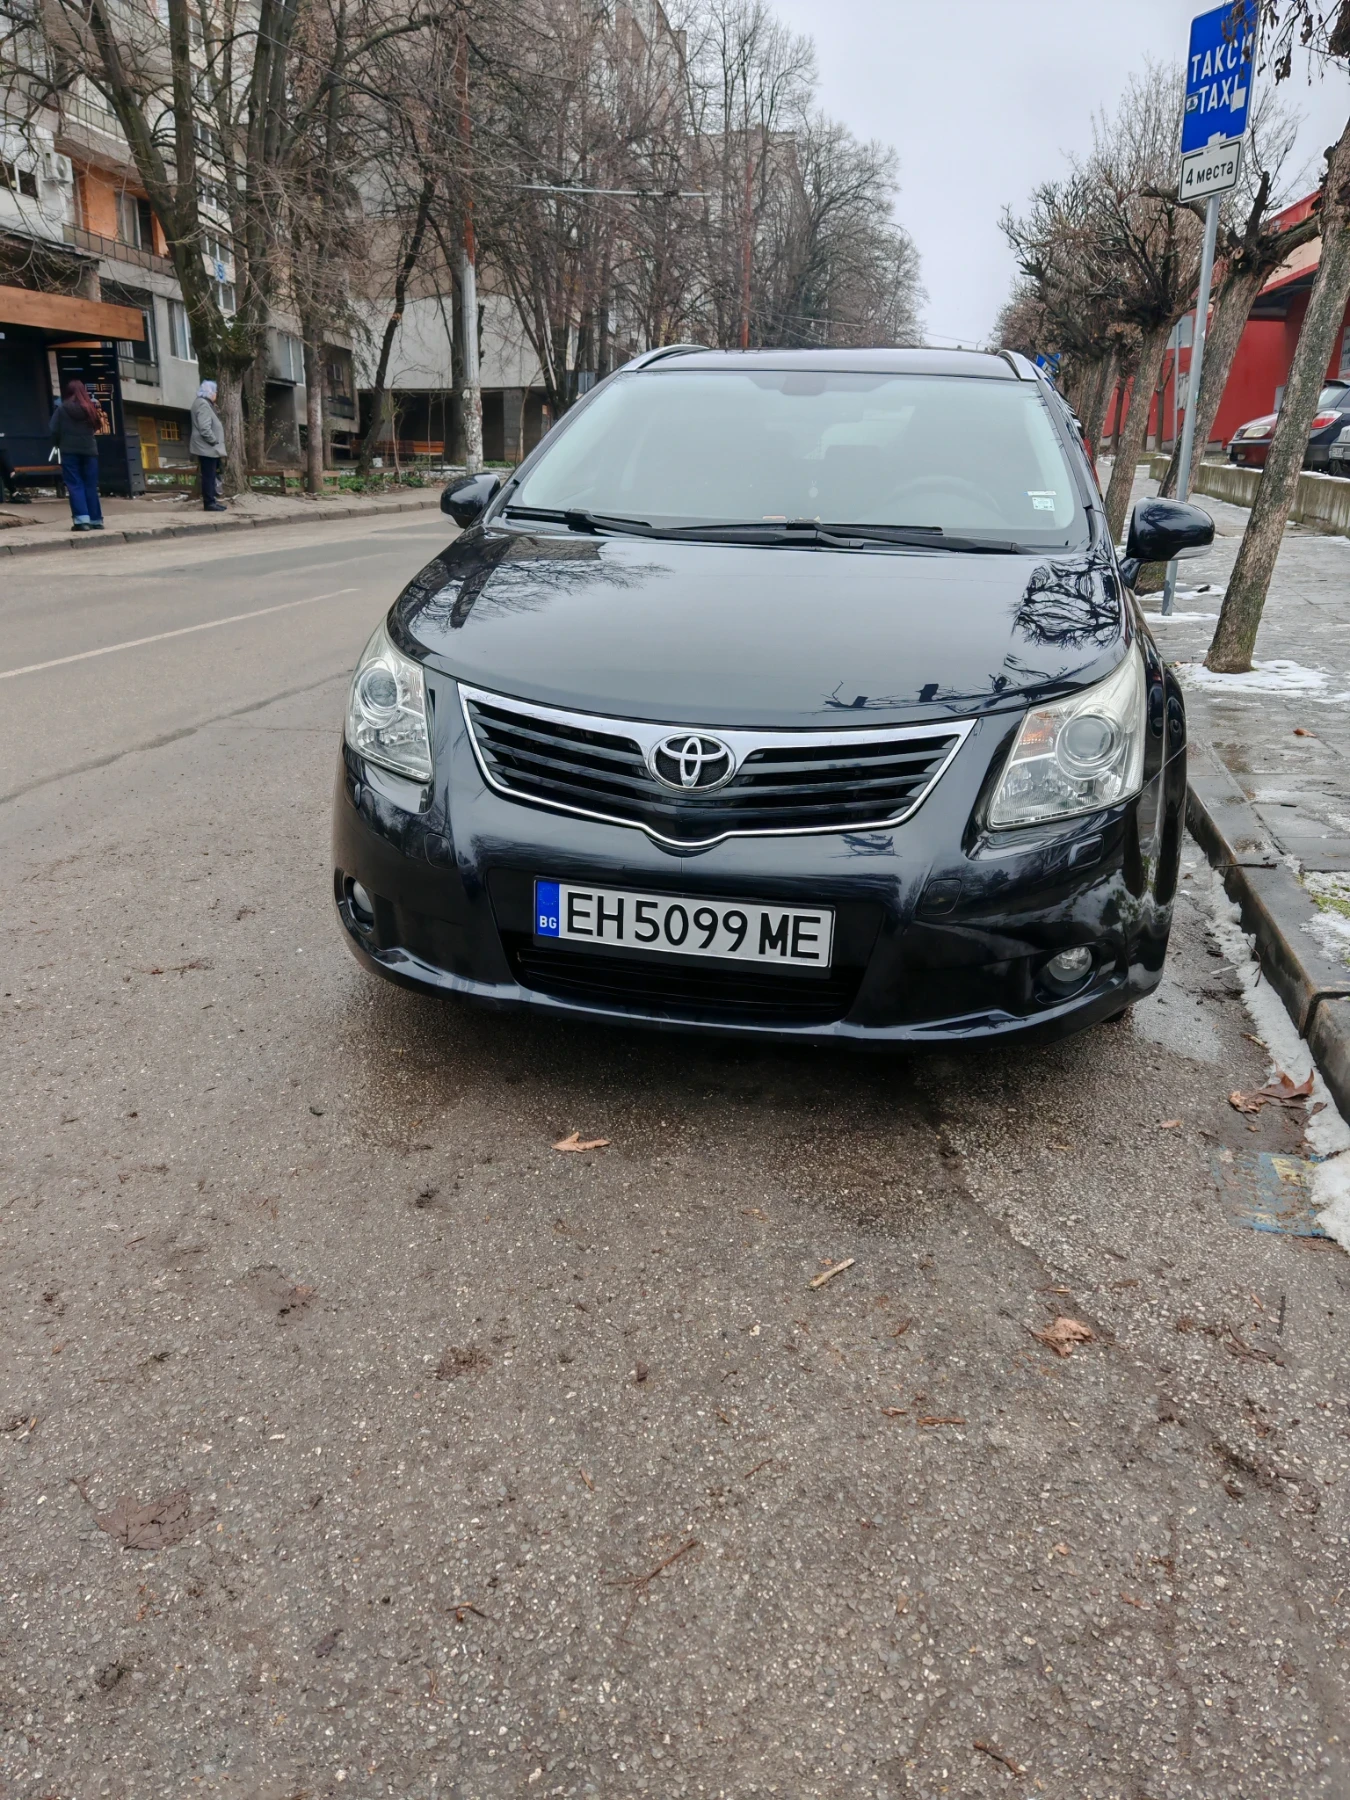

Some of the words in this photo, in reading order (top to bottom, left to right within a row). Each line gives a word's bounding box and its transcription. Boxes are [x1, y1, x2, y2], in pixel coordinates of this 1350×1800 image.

[1185, 167, 1193, 186] 4
[1196, 162, 1234, 184] места
[539, 915, 557, 930] BG
